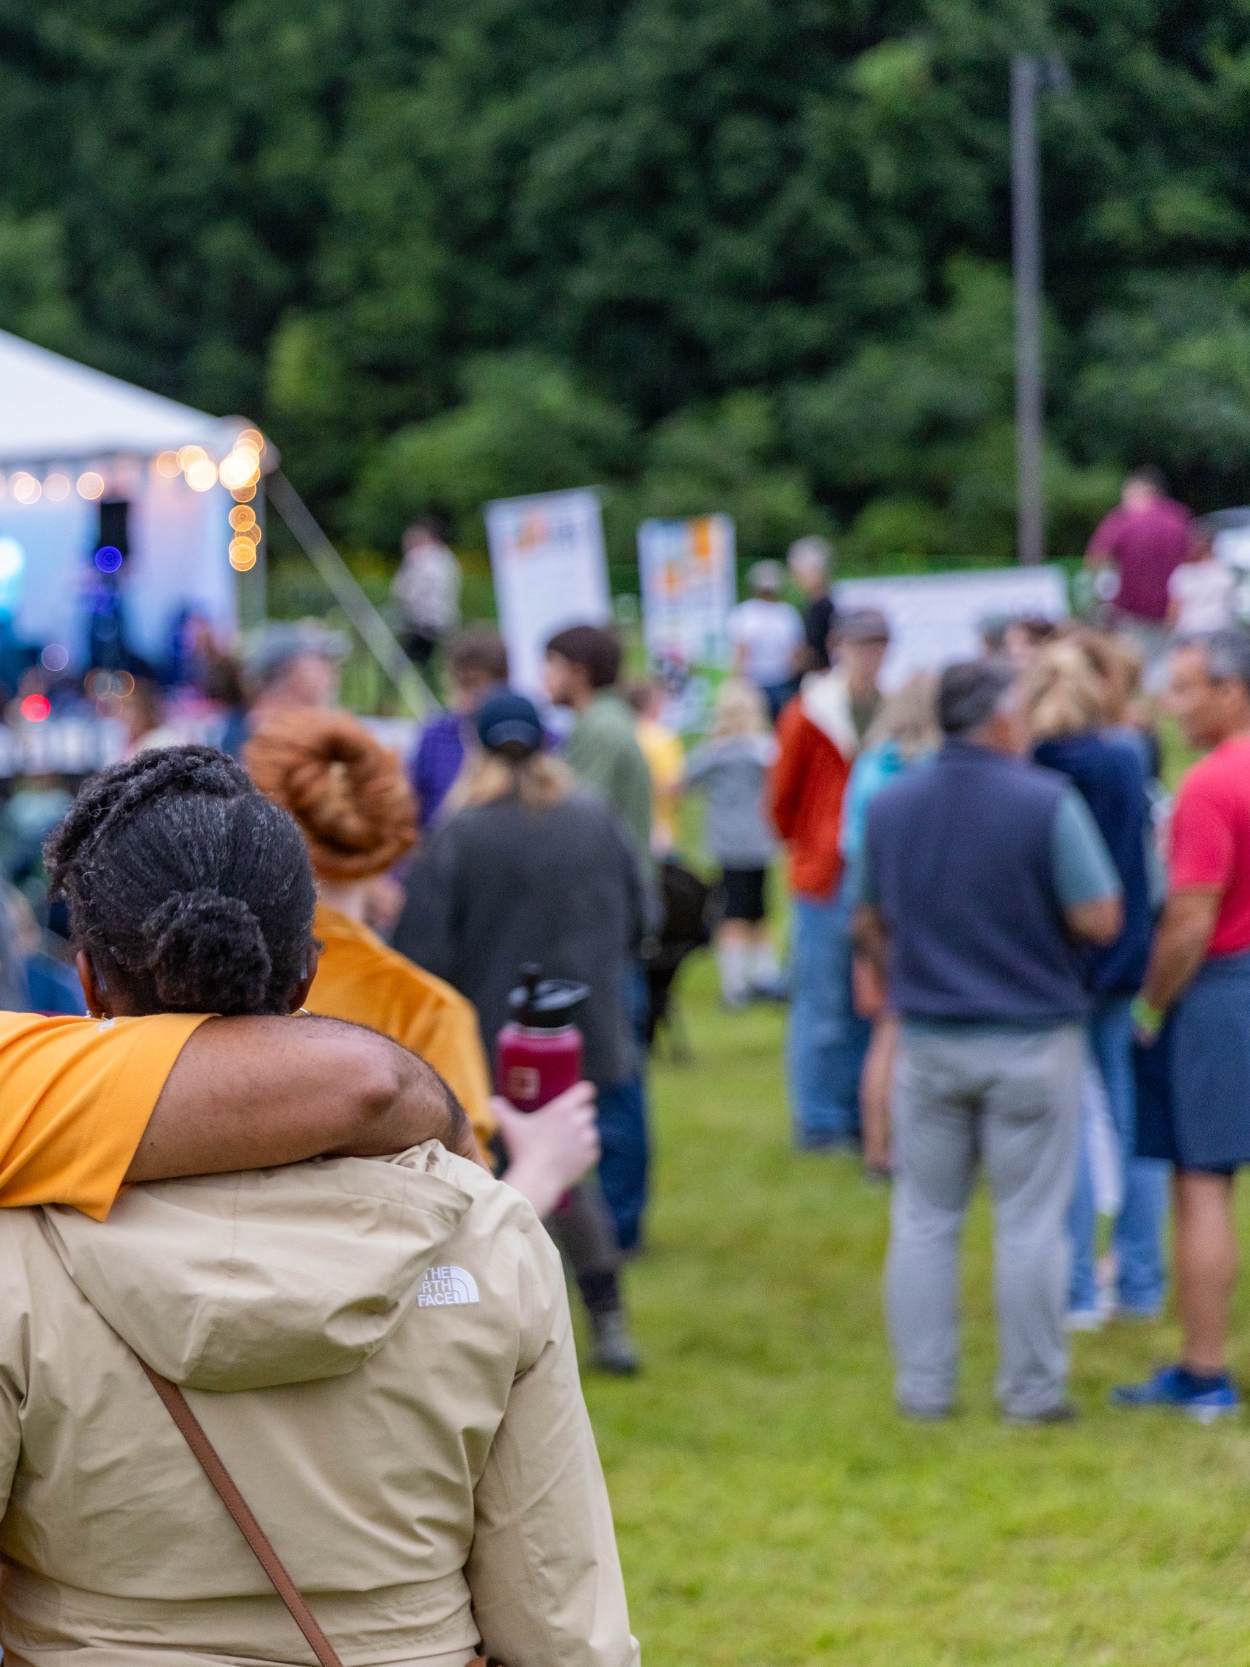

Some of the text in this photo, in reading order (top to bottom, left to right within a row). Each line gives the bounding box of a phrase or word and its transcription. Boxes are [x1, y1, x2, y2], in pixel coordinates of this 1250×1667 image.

[424, 1266, 450, 1280] THE
[420, 1279, 452, 1293] RTH
[418, 1292, 454, 1307] FACE
